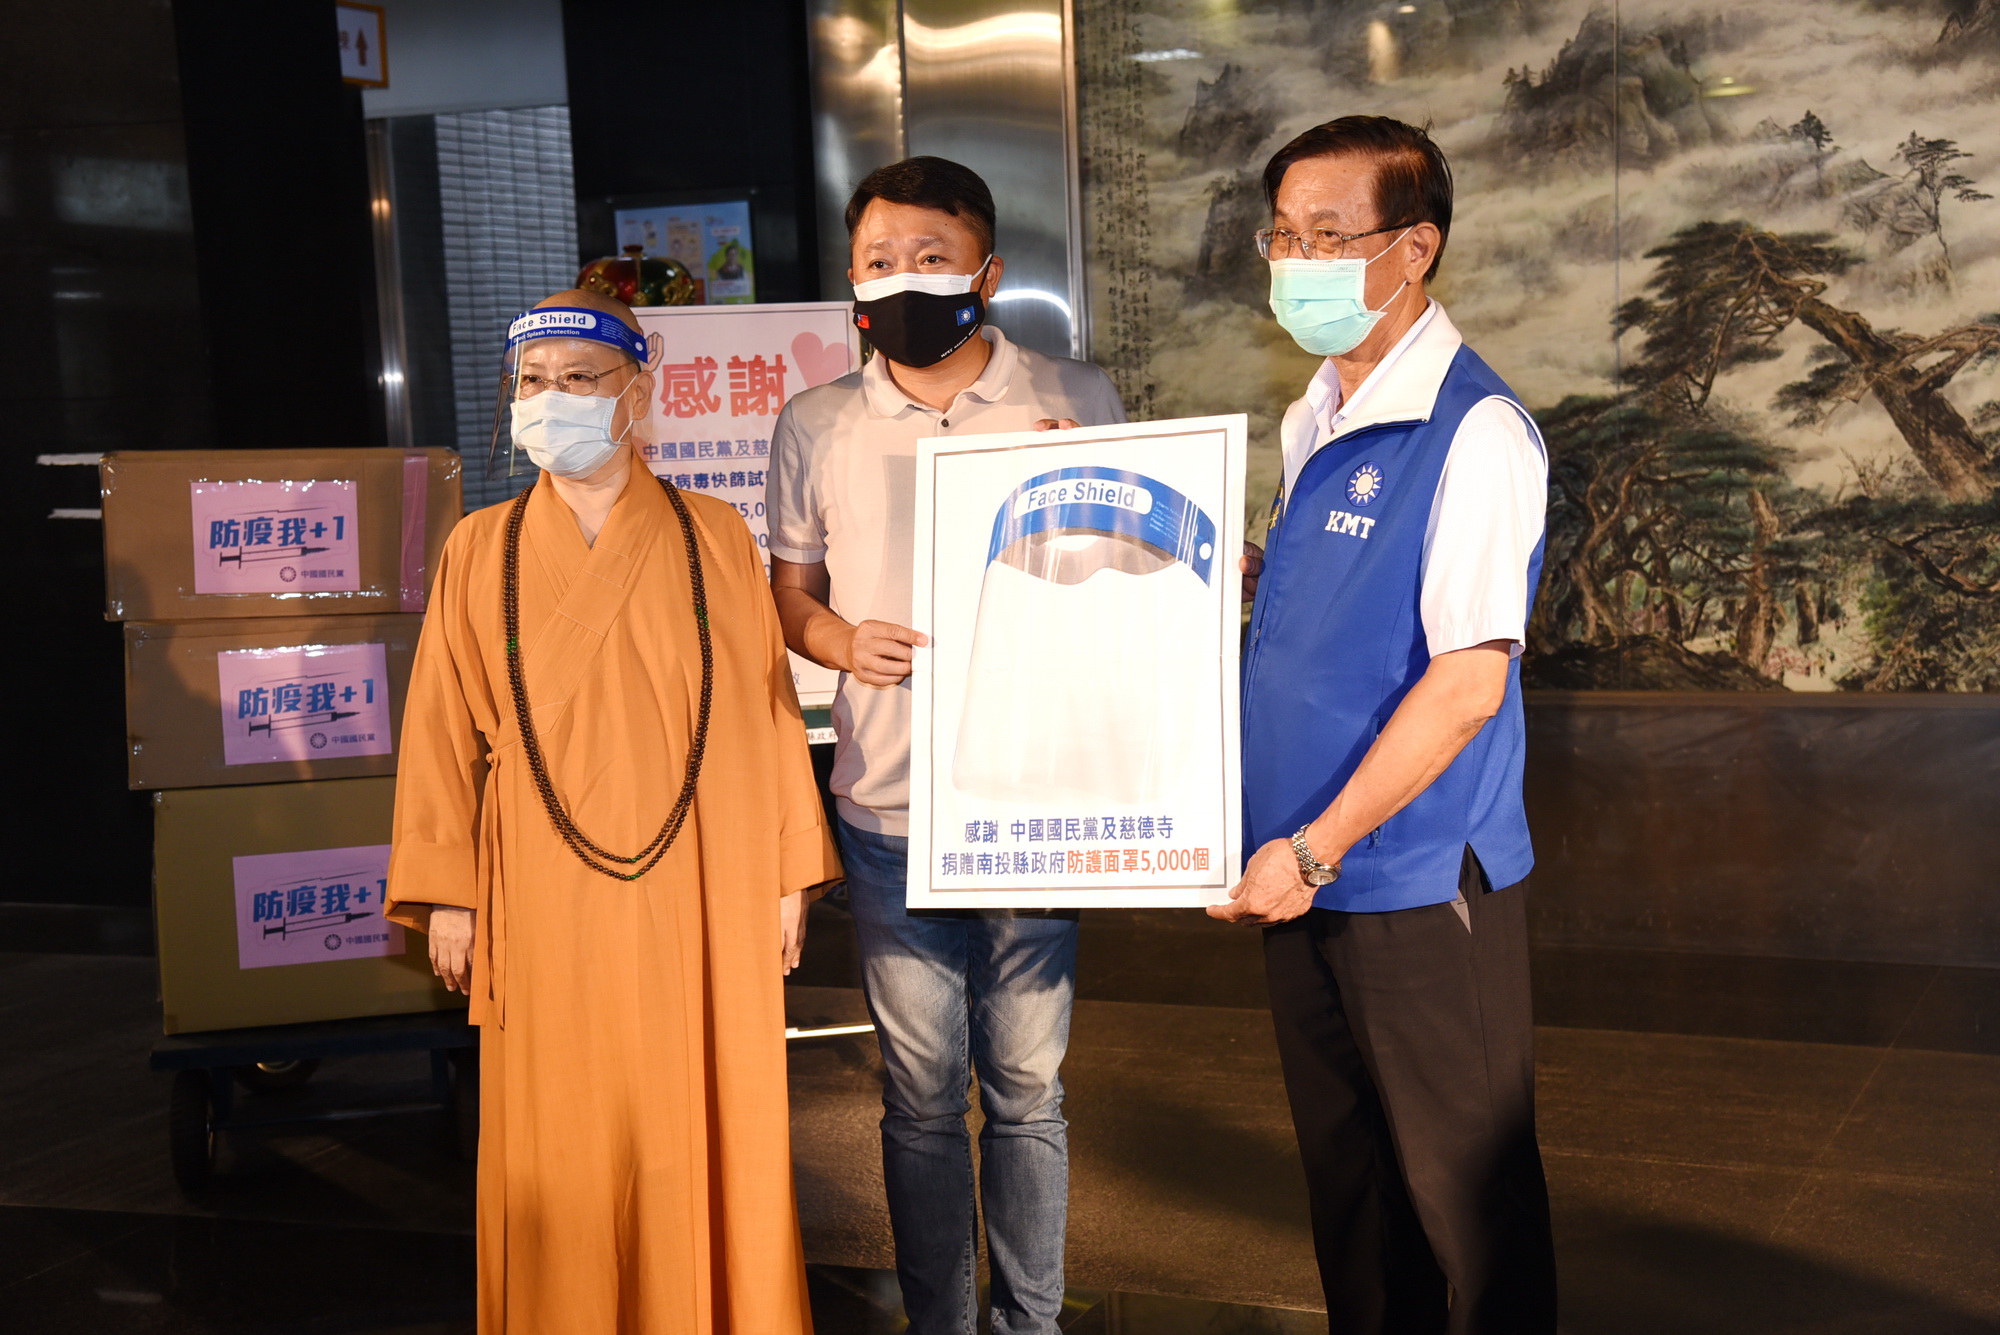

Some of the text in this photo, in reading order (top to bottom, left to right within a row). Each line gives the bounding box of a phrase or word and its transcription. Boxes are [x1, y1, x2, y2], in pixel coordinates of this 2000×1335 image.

[512, 314, 587, 335] Face Shield
[526, 330, 546, 339] Splash
[546, 328, 580, 336] Protection
[659, 353, 788, 419] 感謝
[642, 439, 769, 460] 中國國民黨及慈
[656, 470, 770, 490] 病毒快篩試
[1027, 481, 1136, 510] Face Shield
[209, 515, 345, 550] 防疫我+1
[1324, 510, 1376, 540] KMT
[301, 570, 344, 579] 中國國民黨
[238, 679, 374, 719] 防疫我+1
[331, 733, 376, 744] 中國國民黨
[964, 815, 1174, 843] 感謝 中國國民黨及慈德寺
[942, 847, 1210, 876] 捐贈南投縣政府防護面罩5,000個
[253, 879, 387, 922] 防疫我+1
[346, 933, 389, 945] 中國國民黨
